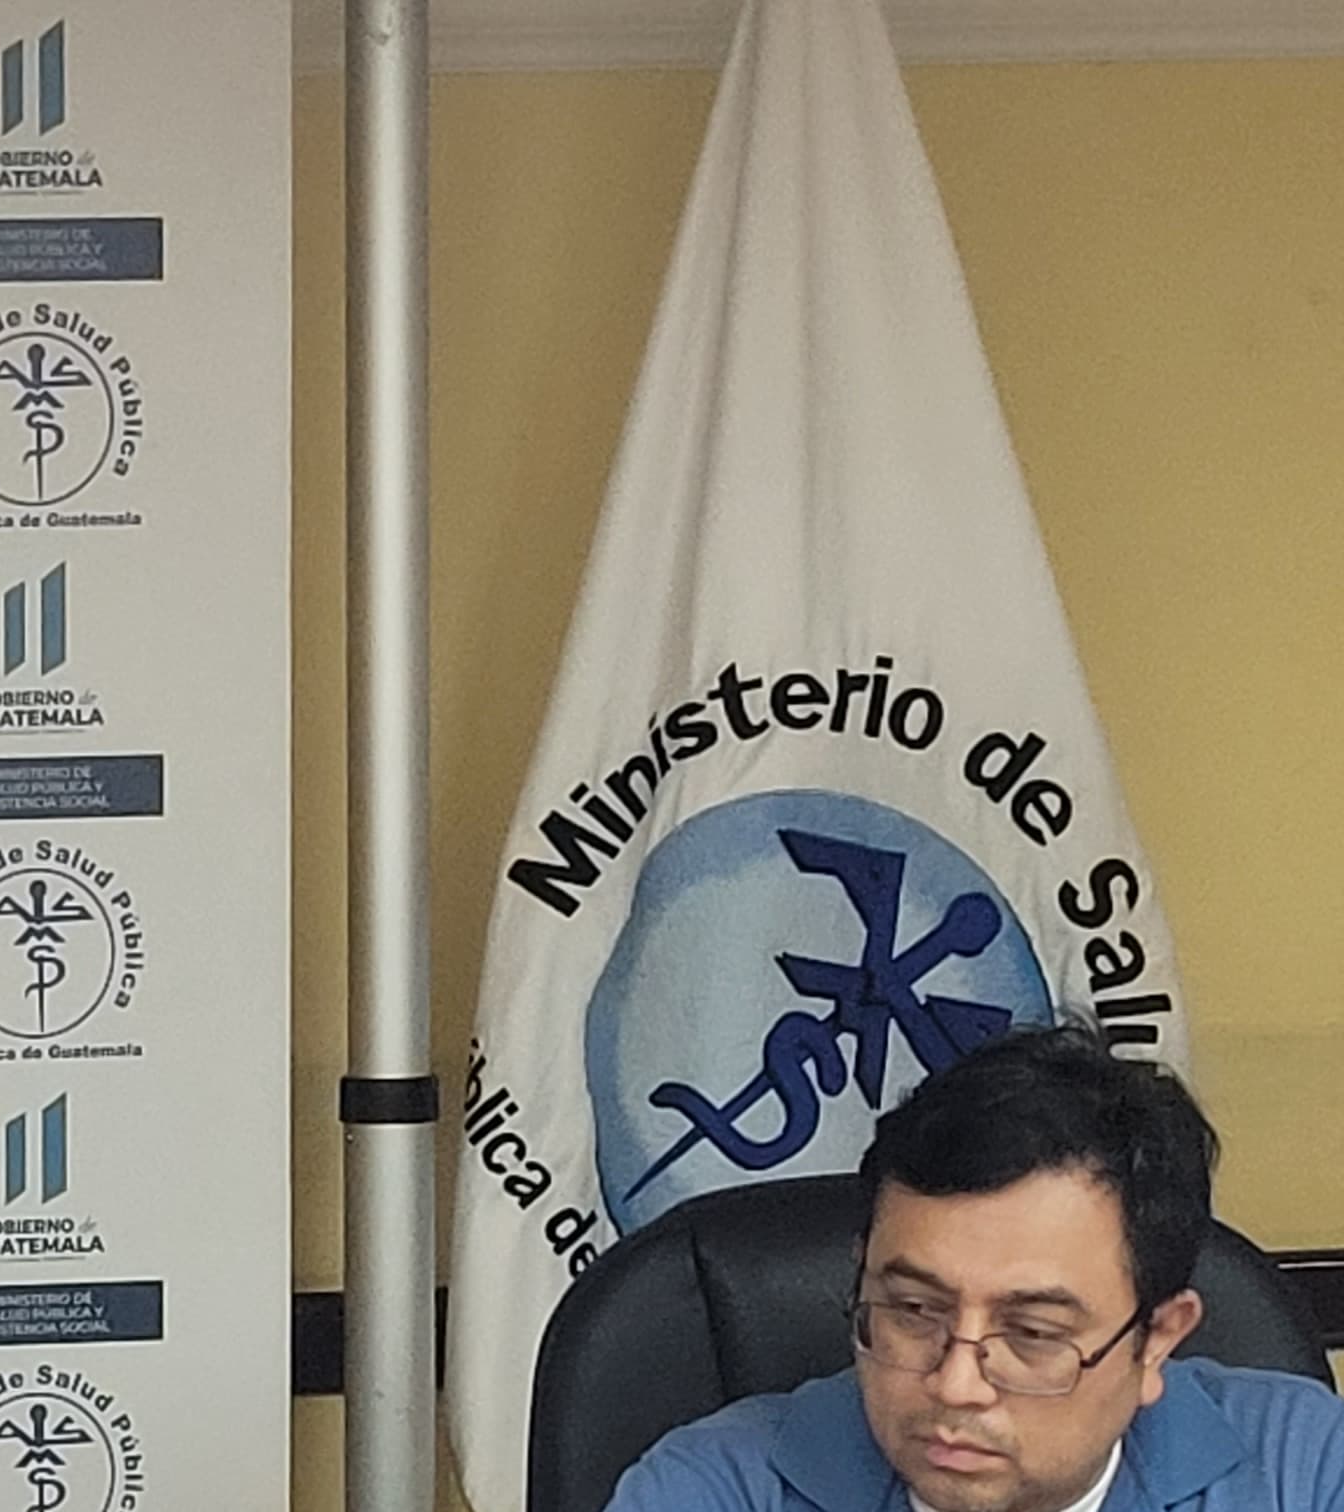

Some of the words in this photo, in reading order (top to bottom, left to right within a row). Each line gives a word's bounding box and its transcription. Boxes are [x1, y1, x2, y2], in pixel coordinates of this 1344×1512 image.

[34, 304, 113, 354] Salud
[110, 356, 143, 476] Pública
[20, 514, 40, 527] de
[46, 512, 142, 527] Guatemala
[507, 656, 943, 918] Ministerio
[963, 732, 1073, 846] de
[1058, 858, 1172, 1075] Salu
[36, 1365, 114, 1412] Salud
